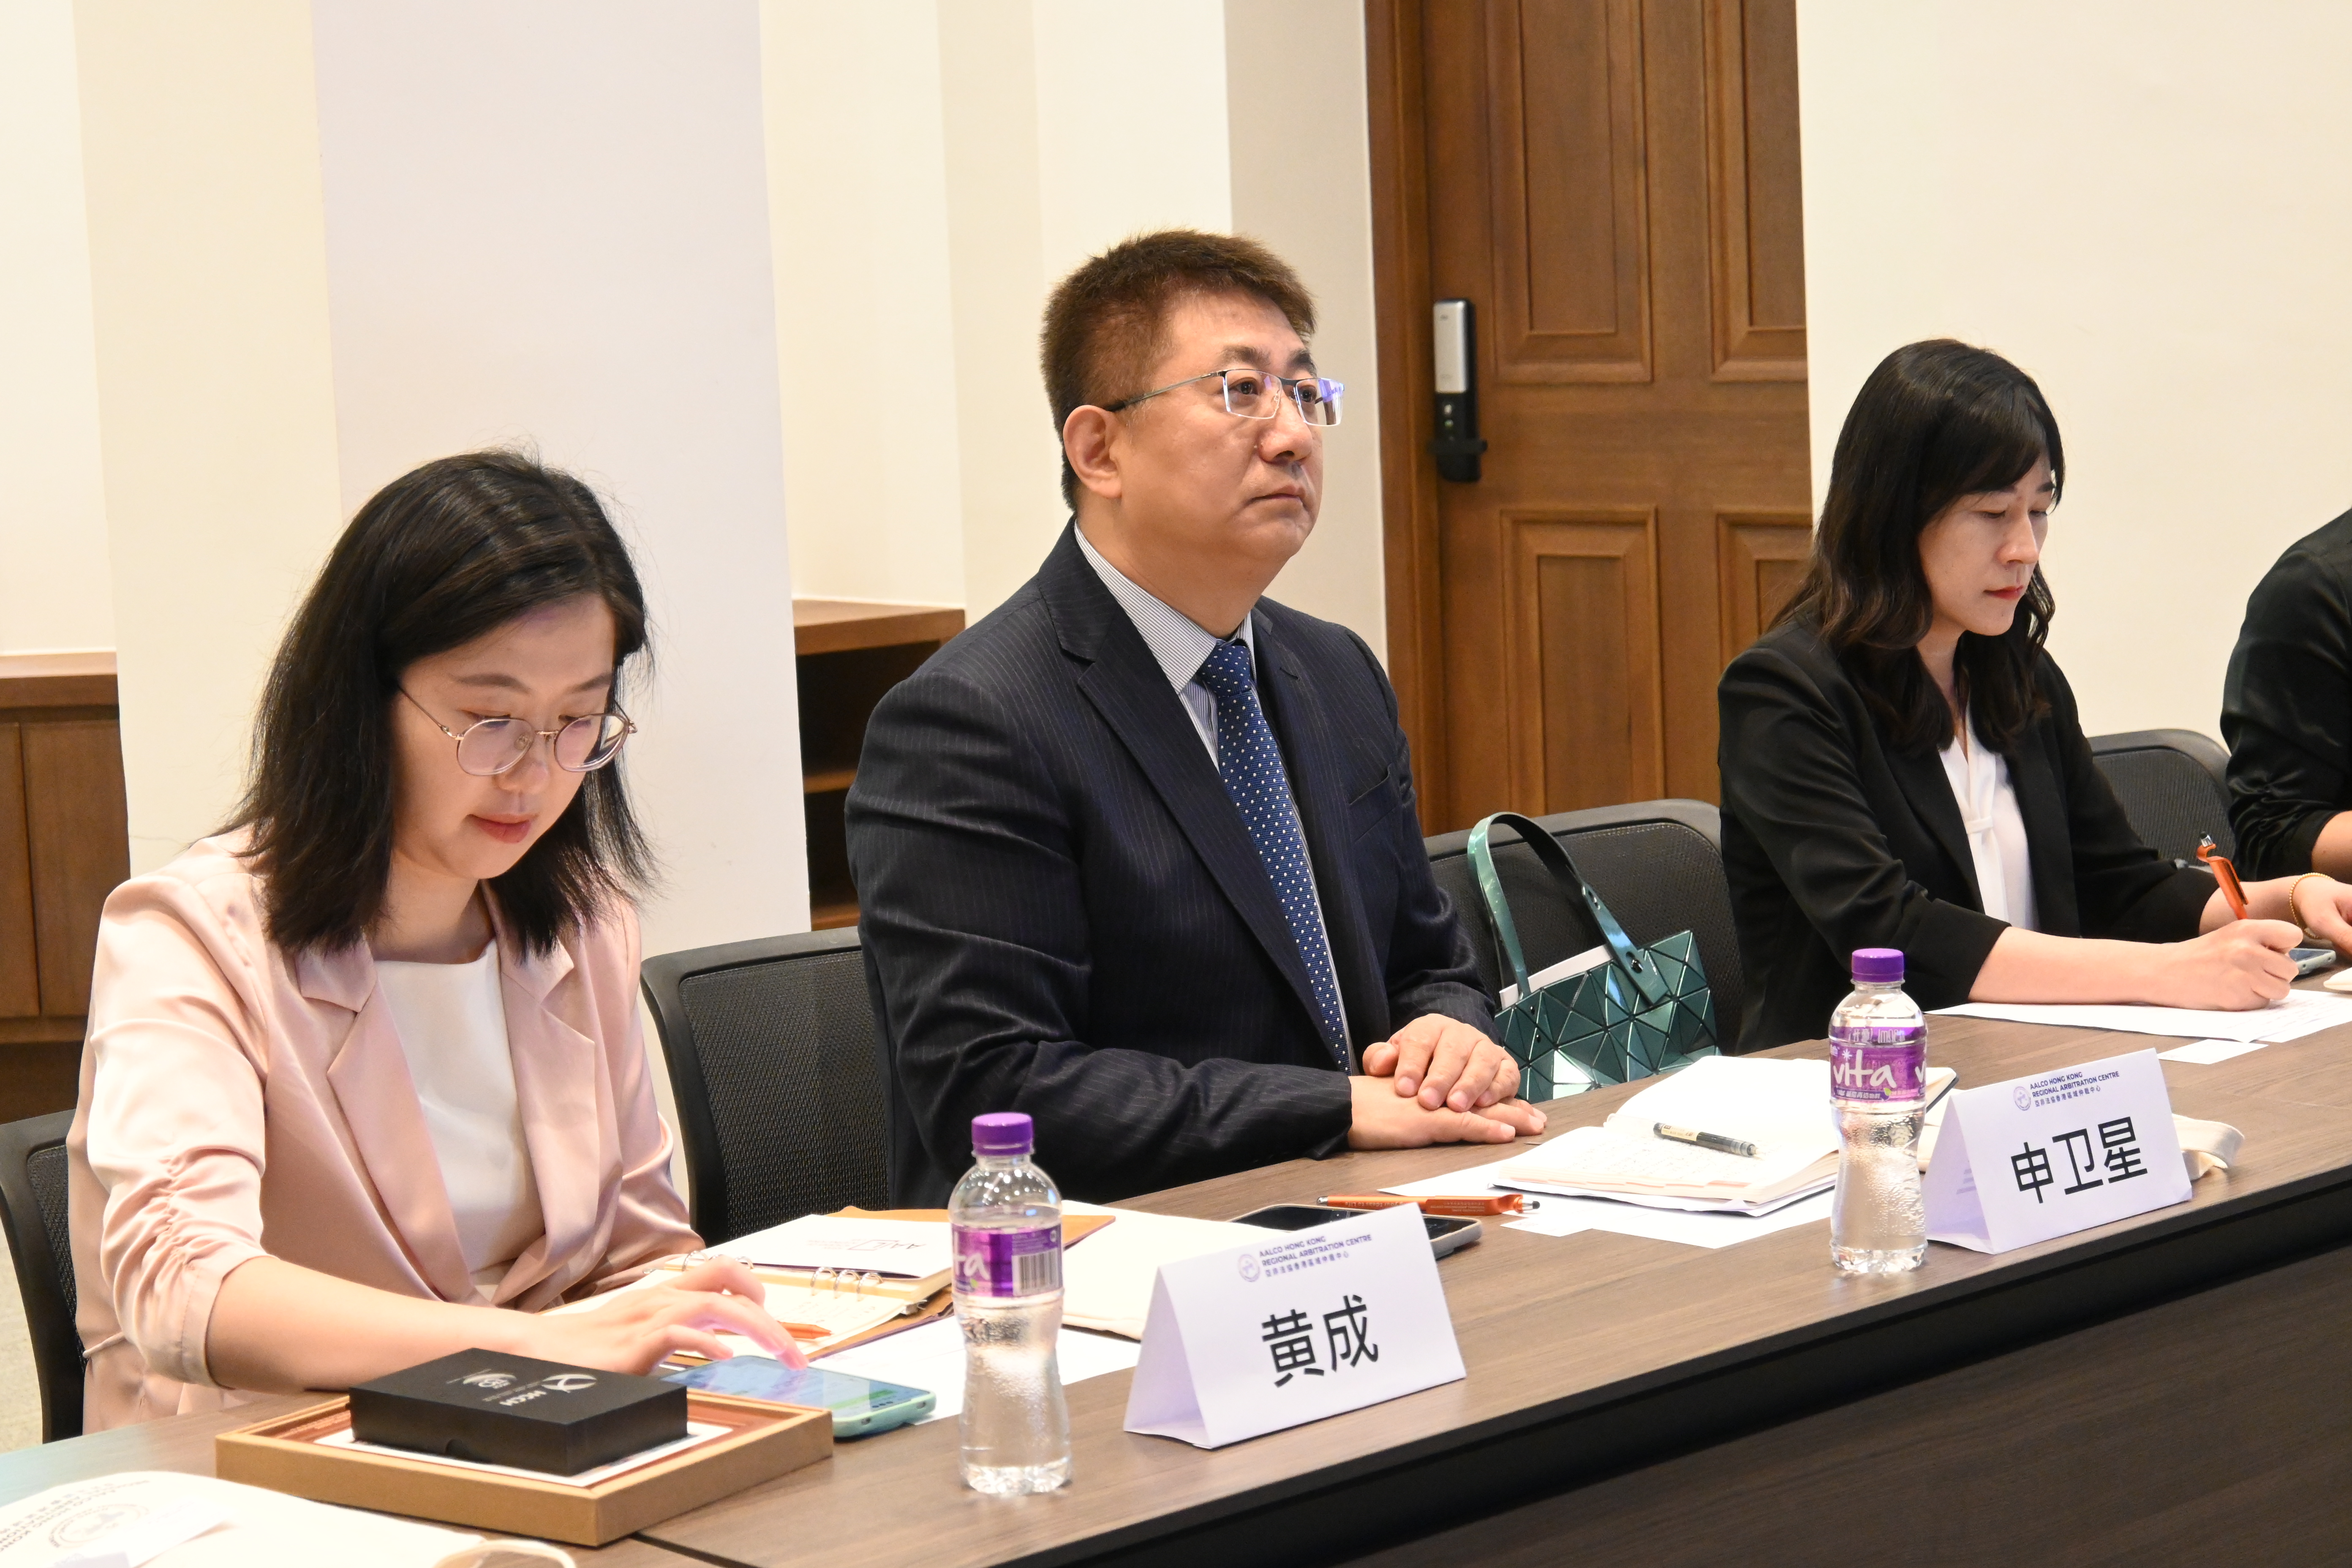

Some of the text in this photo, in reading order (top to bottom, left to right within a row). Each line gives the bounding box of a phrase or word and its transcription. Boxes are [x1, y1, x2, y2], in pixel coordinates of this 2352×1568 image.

[1833, 1049, 1897, 1088] vita
[2030, 1072, 2082, 1090] AALCO HONG KONG
[2032, 1071, 2120, 1097] REGIONAL ARBITRATION CENTRE
[2011, 1116, 2148, 1204] 申卫星
[1259, 1236, 1326, 1258] AALCO HONG KONG
[1262, 1234, 1372, 1266] REGIONAL ARBITRATION CENTRE
[1261, 1295, 1379, 1388] 黄成
